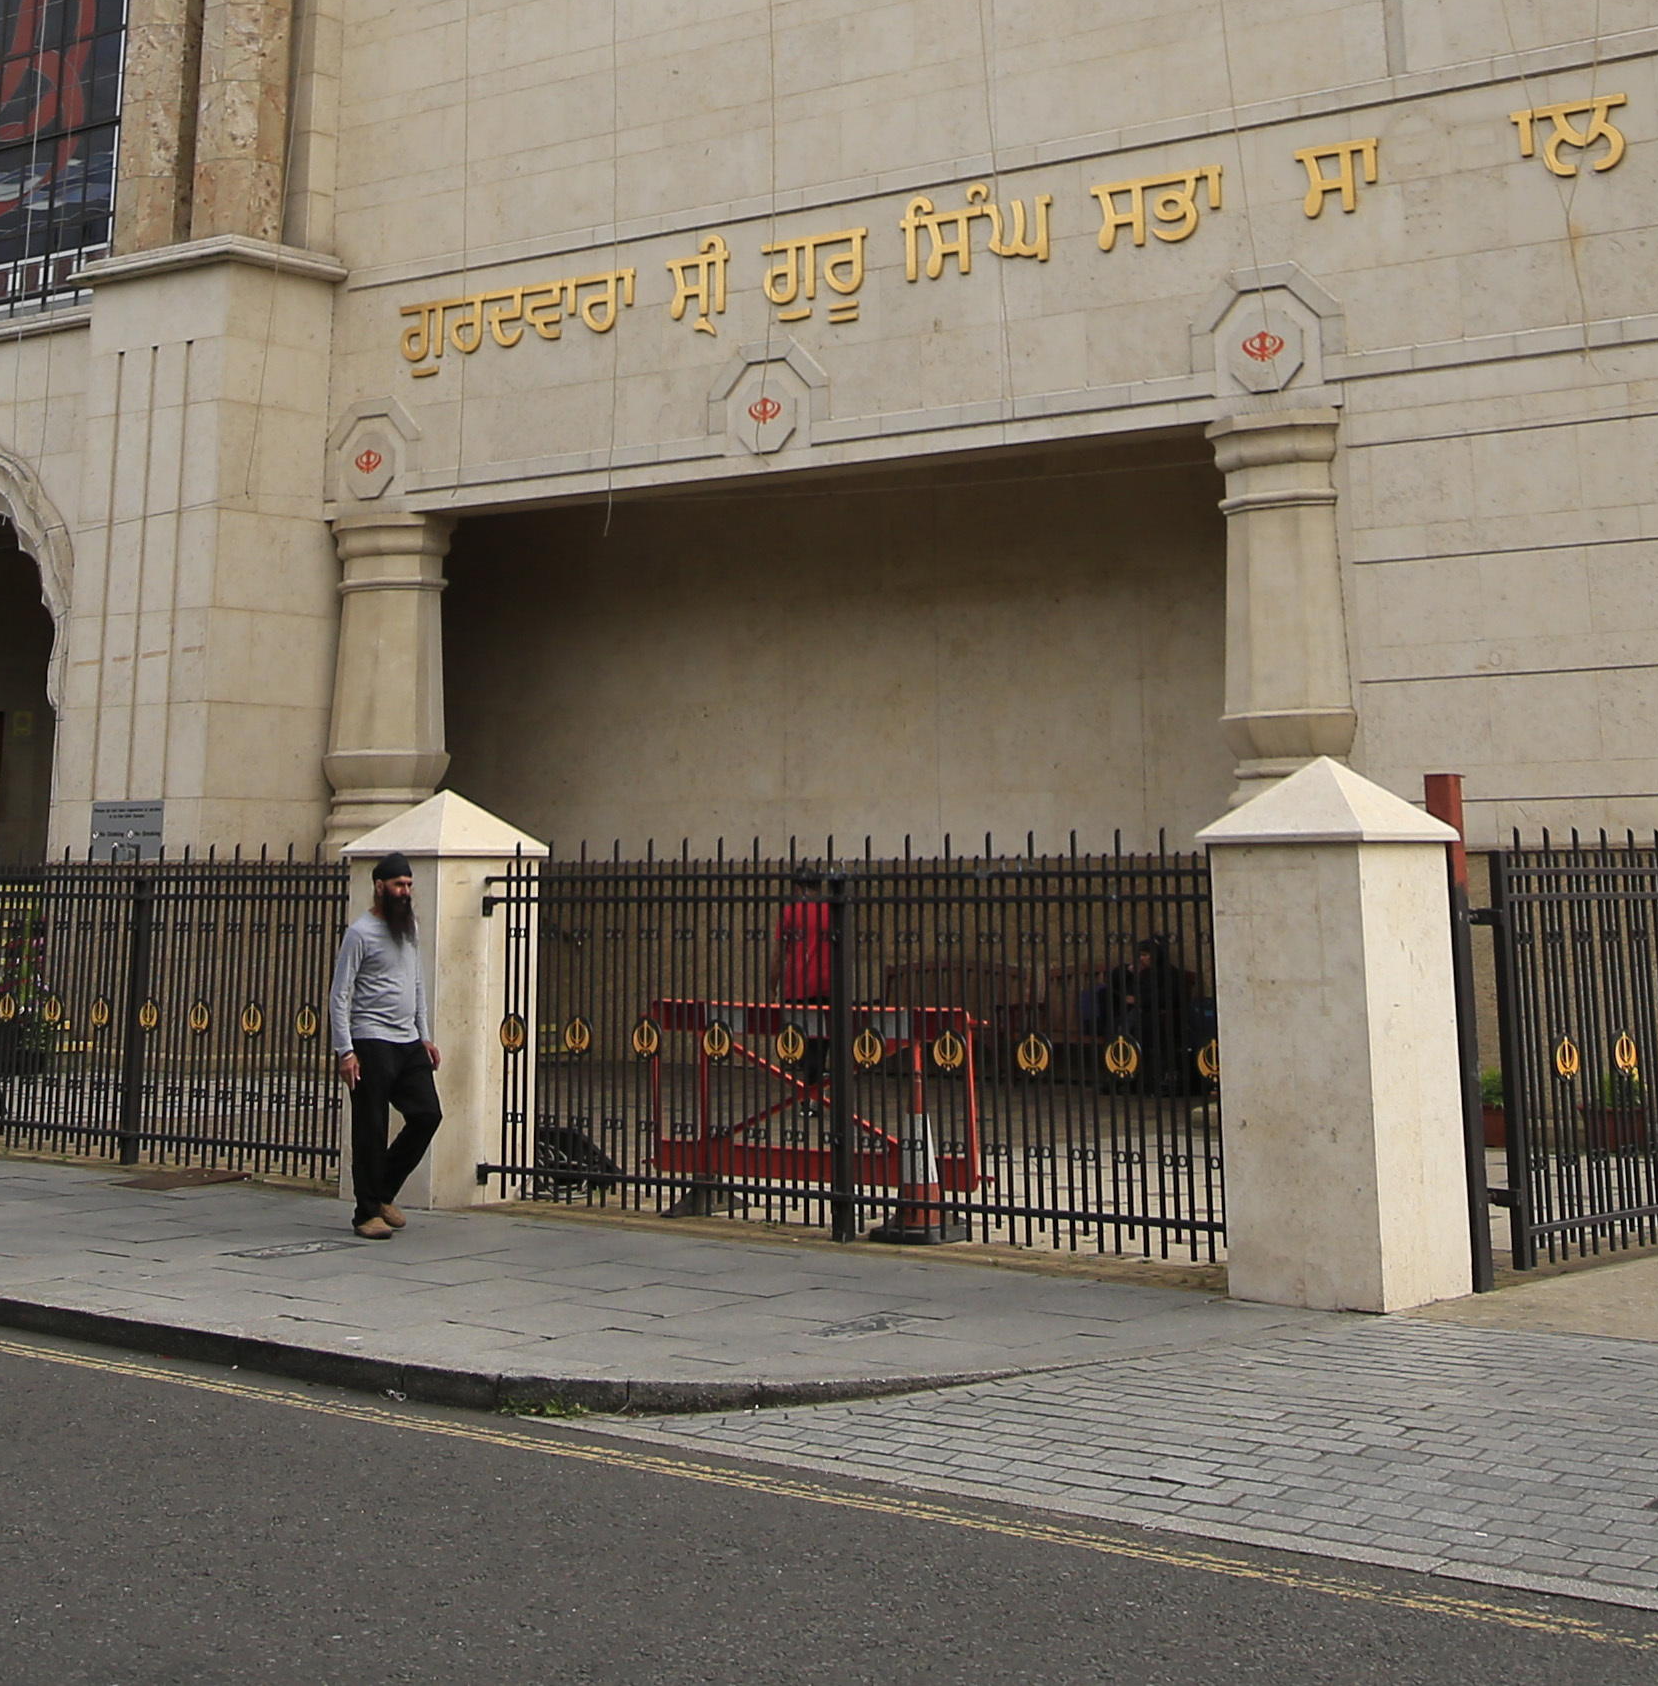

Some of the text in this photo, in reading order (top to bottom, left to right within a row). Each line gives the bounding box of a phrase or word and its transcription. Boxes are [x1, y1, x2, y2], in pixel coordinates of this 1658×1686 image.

[398, 267, 637, 379] ਗੁਰਦਵਾਰਾ
[760, 226, 868, 323] ਗੁਰੂ
[898, 182, 1053, 283] ਸਿੰਘ
[1089, 164, 1224, 253] ਸਭਾ
